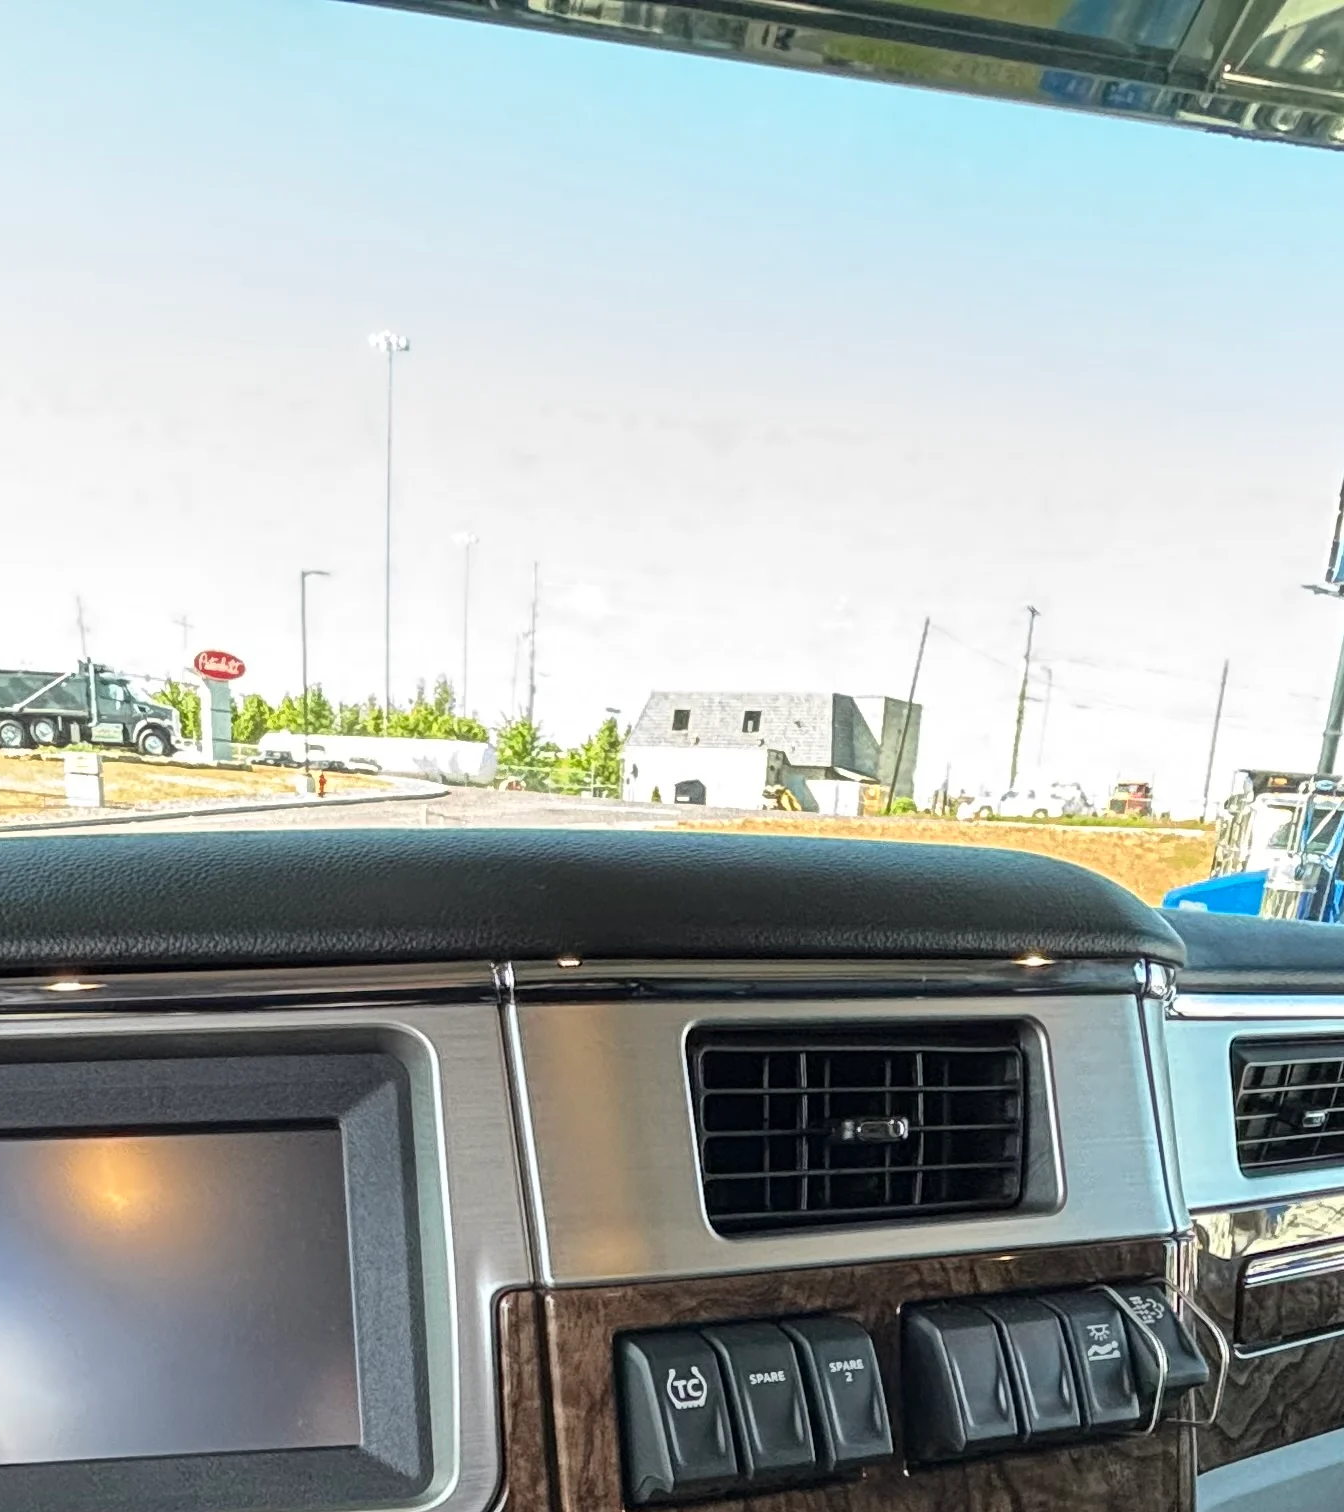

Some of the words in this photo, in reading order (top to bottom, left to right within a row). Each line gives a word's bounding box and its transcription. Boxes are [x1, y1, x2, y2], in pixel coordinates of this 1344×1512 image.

[828, 1358, 865, 1373] SPARE
[749, 1370, 786, 1385] SPARE
[845, 1371, 854, 1382] 2
[673, 1378, 703, 1399] TC
